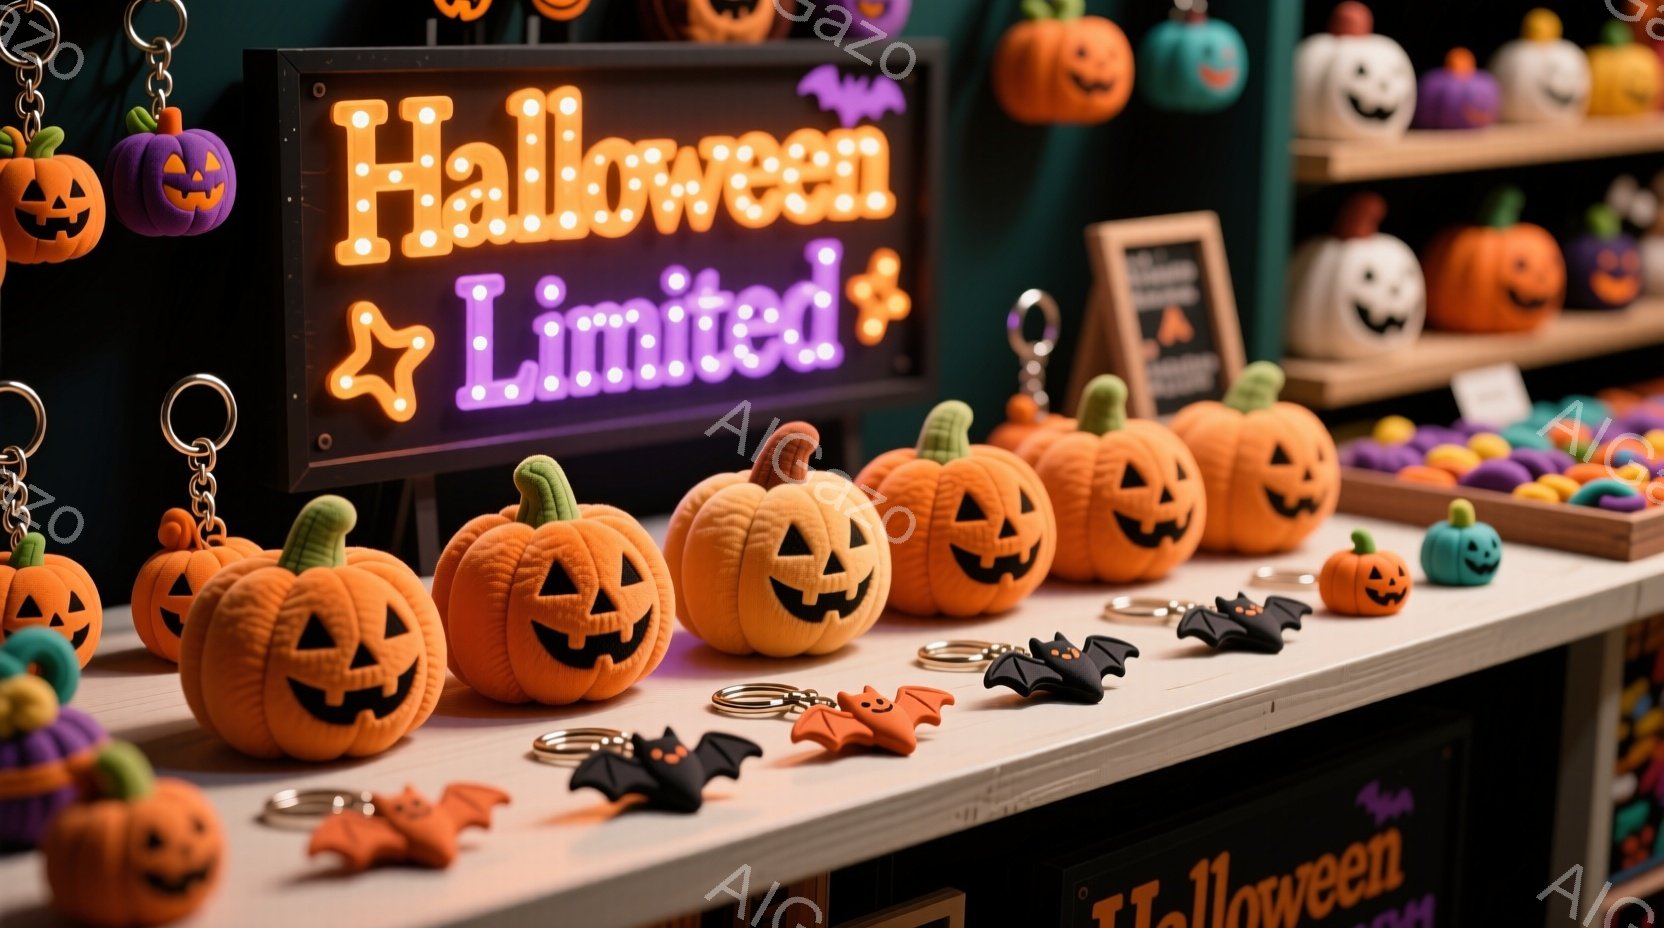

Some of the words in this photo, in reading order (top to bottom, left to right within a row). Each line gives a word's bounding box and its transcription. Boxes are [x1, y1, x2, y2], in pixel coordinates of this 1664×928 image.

[332, 84, 897, 267] Halloween
[454, 238, 845, 412] Limited
[1092, 827, 1405, 928] lloween
